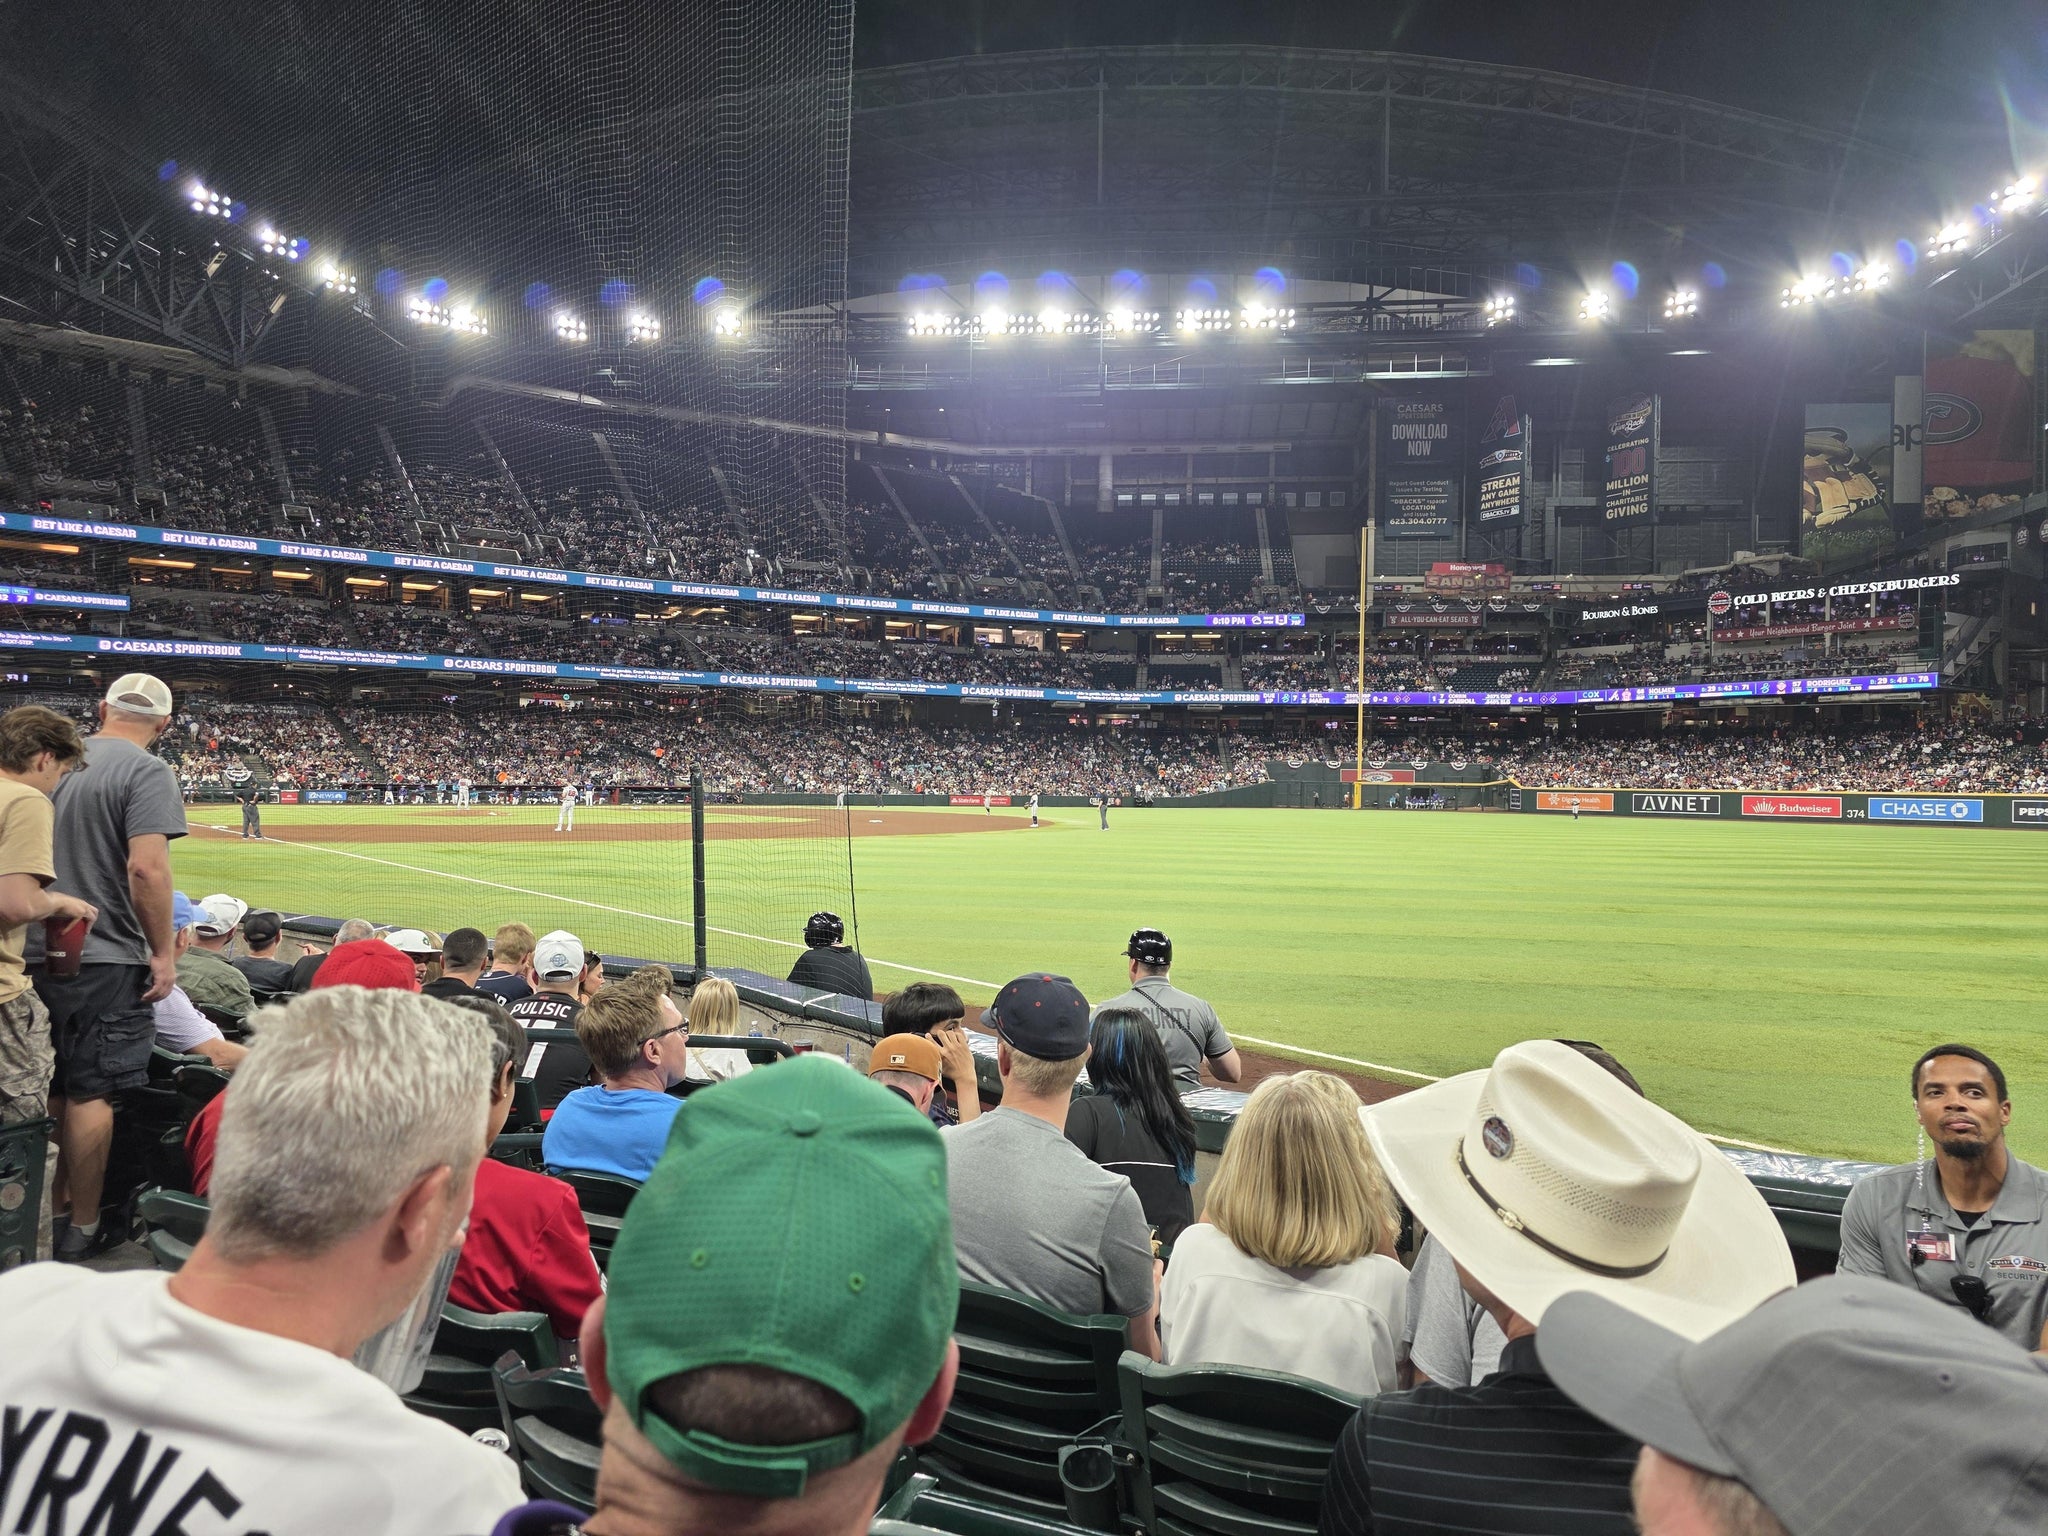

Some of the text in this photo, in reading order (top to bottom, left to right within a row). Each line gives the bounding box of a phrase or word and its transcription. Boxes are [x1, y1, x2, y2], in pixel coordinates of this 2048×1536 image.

[1397, 403, 1444, 412] CAESARS
[1392, 423, 1447, 440] DOWNLOAD
[1407, 440, 1431, 456] NOW
[1607, 438, 1649, 452] CELEBRATING
[1481, 476, 1520, 492] STREAM
[1606, 474, 1649, 491] MILLION
[1481, 487, 1520, 501] ANY GAME
[1622, 488, 1631, 496] IN
[1481, 496, 1520, 510] ANYWHERE
[1606, 494, 1649, 507] CHARITABLE
[1606, 503, 1648, 520] GIVING
[33, 518, 137, 538] BET LIKE A CAESAR
[162, 532, 257, 551] BET LIKE A CAESAR
[281, 544, 367, 562] BET LIKE A CAESAR
[394, 556, 474, 572] BET LIKE A CAESAR
[1450, 564, 1487, 573] Honeywell
[494, 566, 567, 582] BET LIKE A CAESAR
[585, 576, 600, 585] BET
[601, 578, 618, 586] LIKE
[625, 580, 654, 590] CAESAR
[1428, 575, 1508, 587] SANDOT
[671, 584, 739, 597] BET LIKE A CAESAR
[1734, 594, 1768, 606] COLD
[1771, 588, 1815, 602] BEERS
[1818, 587, 1827, 598] &
[1829, 574, 1960, 597] CHEESEBURGERS
[44, 593, 128, 606] CAESARS SPORTSBOOK
[756, 591, 771, 599] BET
[771, 592, 787, 600] LIKE
[793, 594, 820, 603] CAESAR
[836, 597, 851, 605] BET
[851, 598, 865, 606] LIKE
[871, 600, 897, 608] CAESAR
[912, 603, 925, 611] BET
[925, 604, 940, 612] LIKE
[945, 606, 969, 614] CAESAR
[984, 608, 996, 616] BET
[1015, 611, 1039, 619] CAESAR
[1621, 607, 1630, 616] &
[1153, 617, 1179, 625] CAESAR
[1231, 616, 1245, 625] PM
[1749, 621, 1856, 638] Your Neighborhood Burger Joint
[113, 641, 242, 656] CAESARS SPORTSBOOK
[454, 660, 557, 674] CAESARS SPORTSBOOK
[728, 675, 817, 687] CAESARS SPORTSBOOK
[1806, 678, 1852, 687] RODRIGUEZ
[969, 686, 1045, 698] CAESARS SPORTSBOOK
[1183, 693, 1219, 702] CAESARS
[1649, 687, 1676, 695] HOLMES
[1642, 795, 1711, 812] AVNET
[1778, 803, 1832, 814] Budweiser
[1881, 802, 1947, 817] CHASE
[1846, 809, 1866, 818] 374
[510, 1001, 572, 1018] PULISIC
[1997, 1272, 2041, 1281] SECURITY
